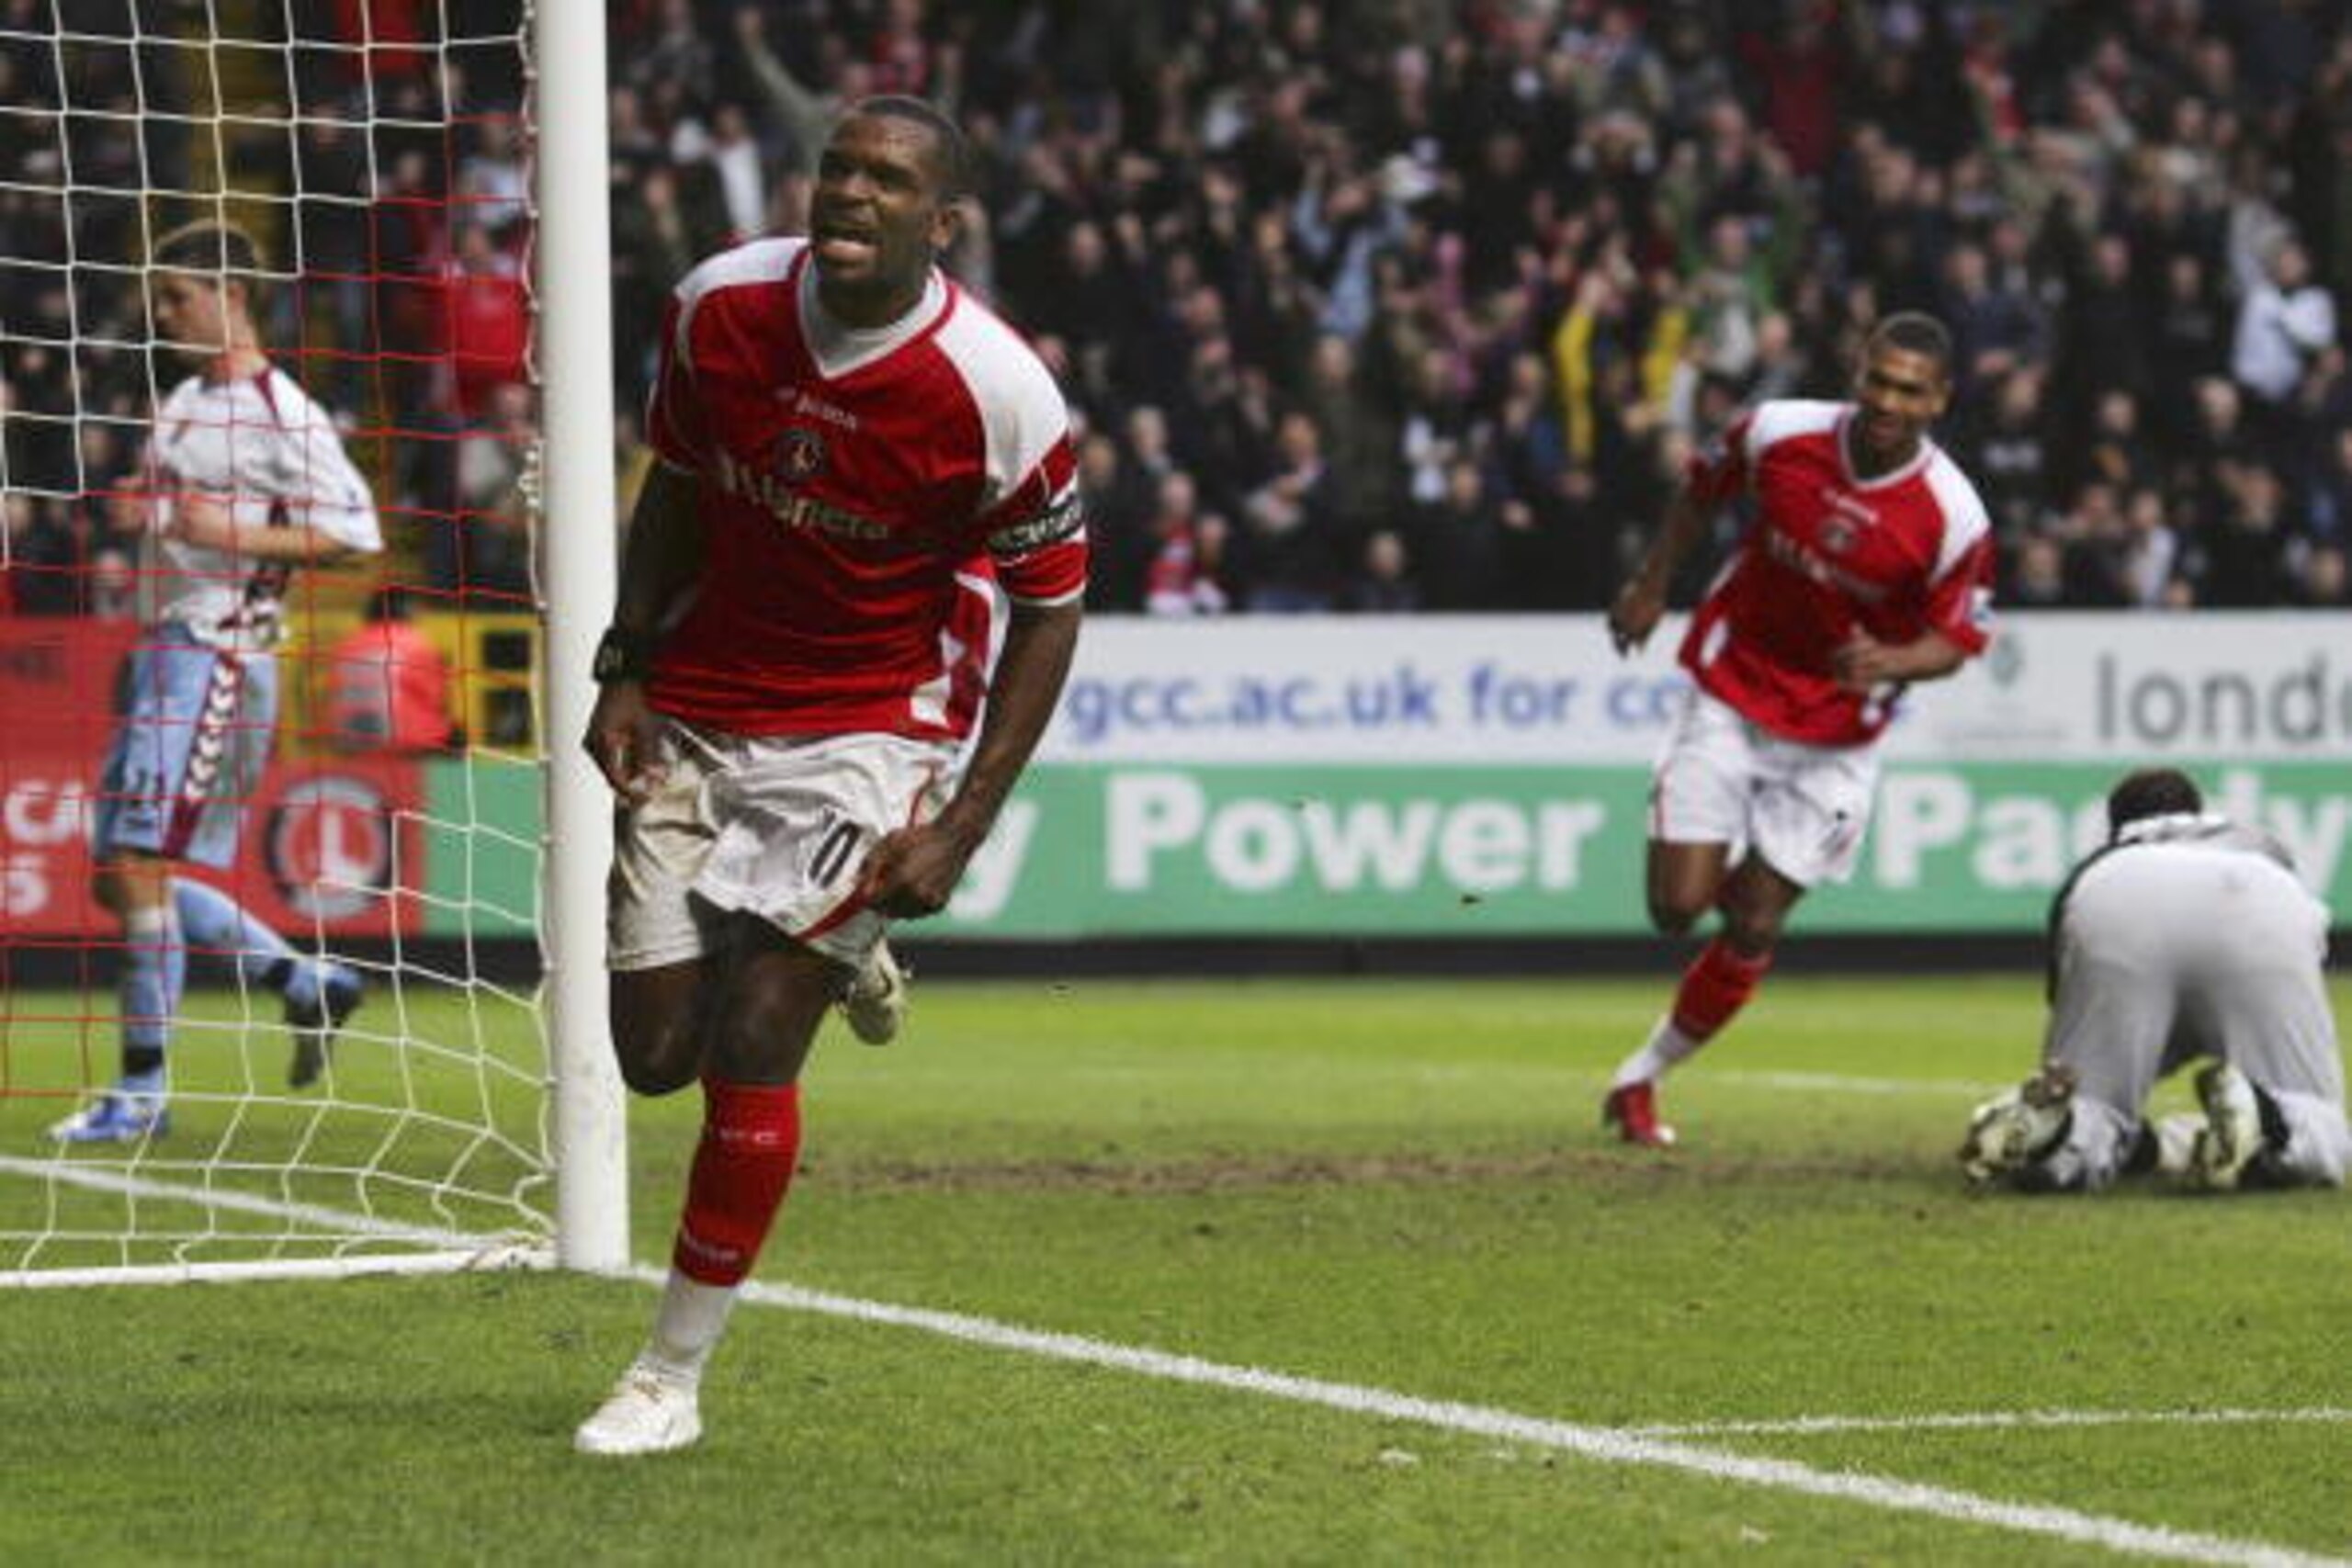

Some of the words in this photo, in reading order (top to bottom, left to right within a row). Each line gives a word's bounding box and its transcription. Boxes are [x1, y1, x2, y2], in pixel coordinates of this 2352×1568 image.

[1069, 663, 1435, 743] gcc.ac.uk
[1472, 663, 1575, 725] for
[2098, 652, 2352, 742] lond
[1105, 773, 1606, 891] Power
